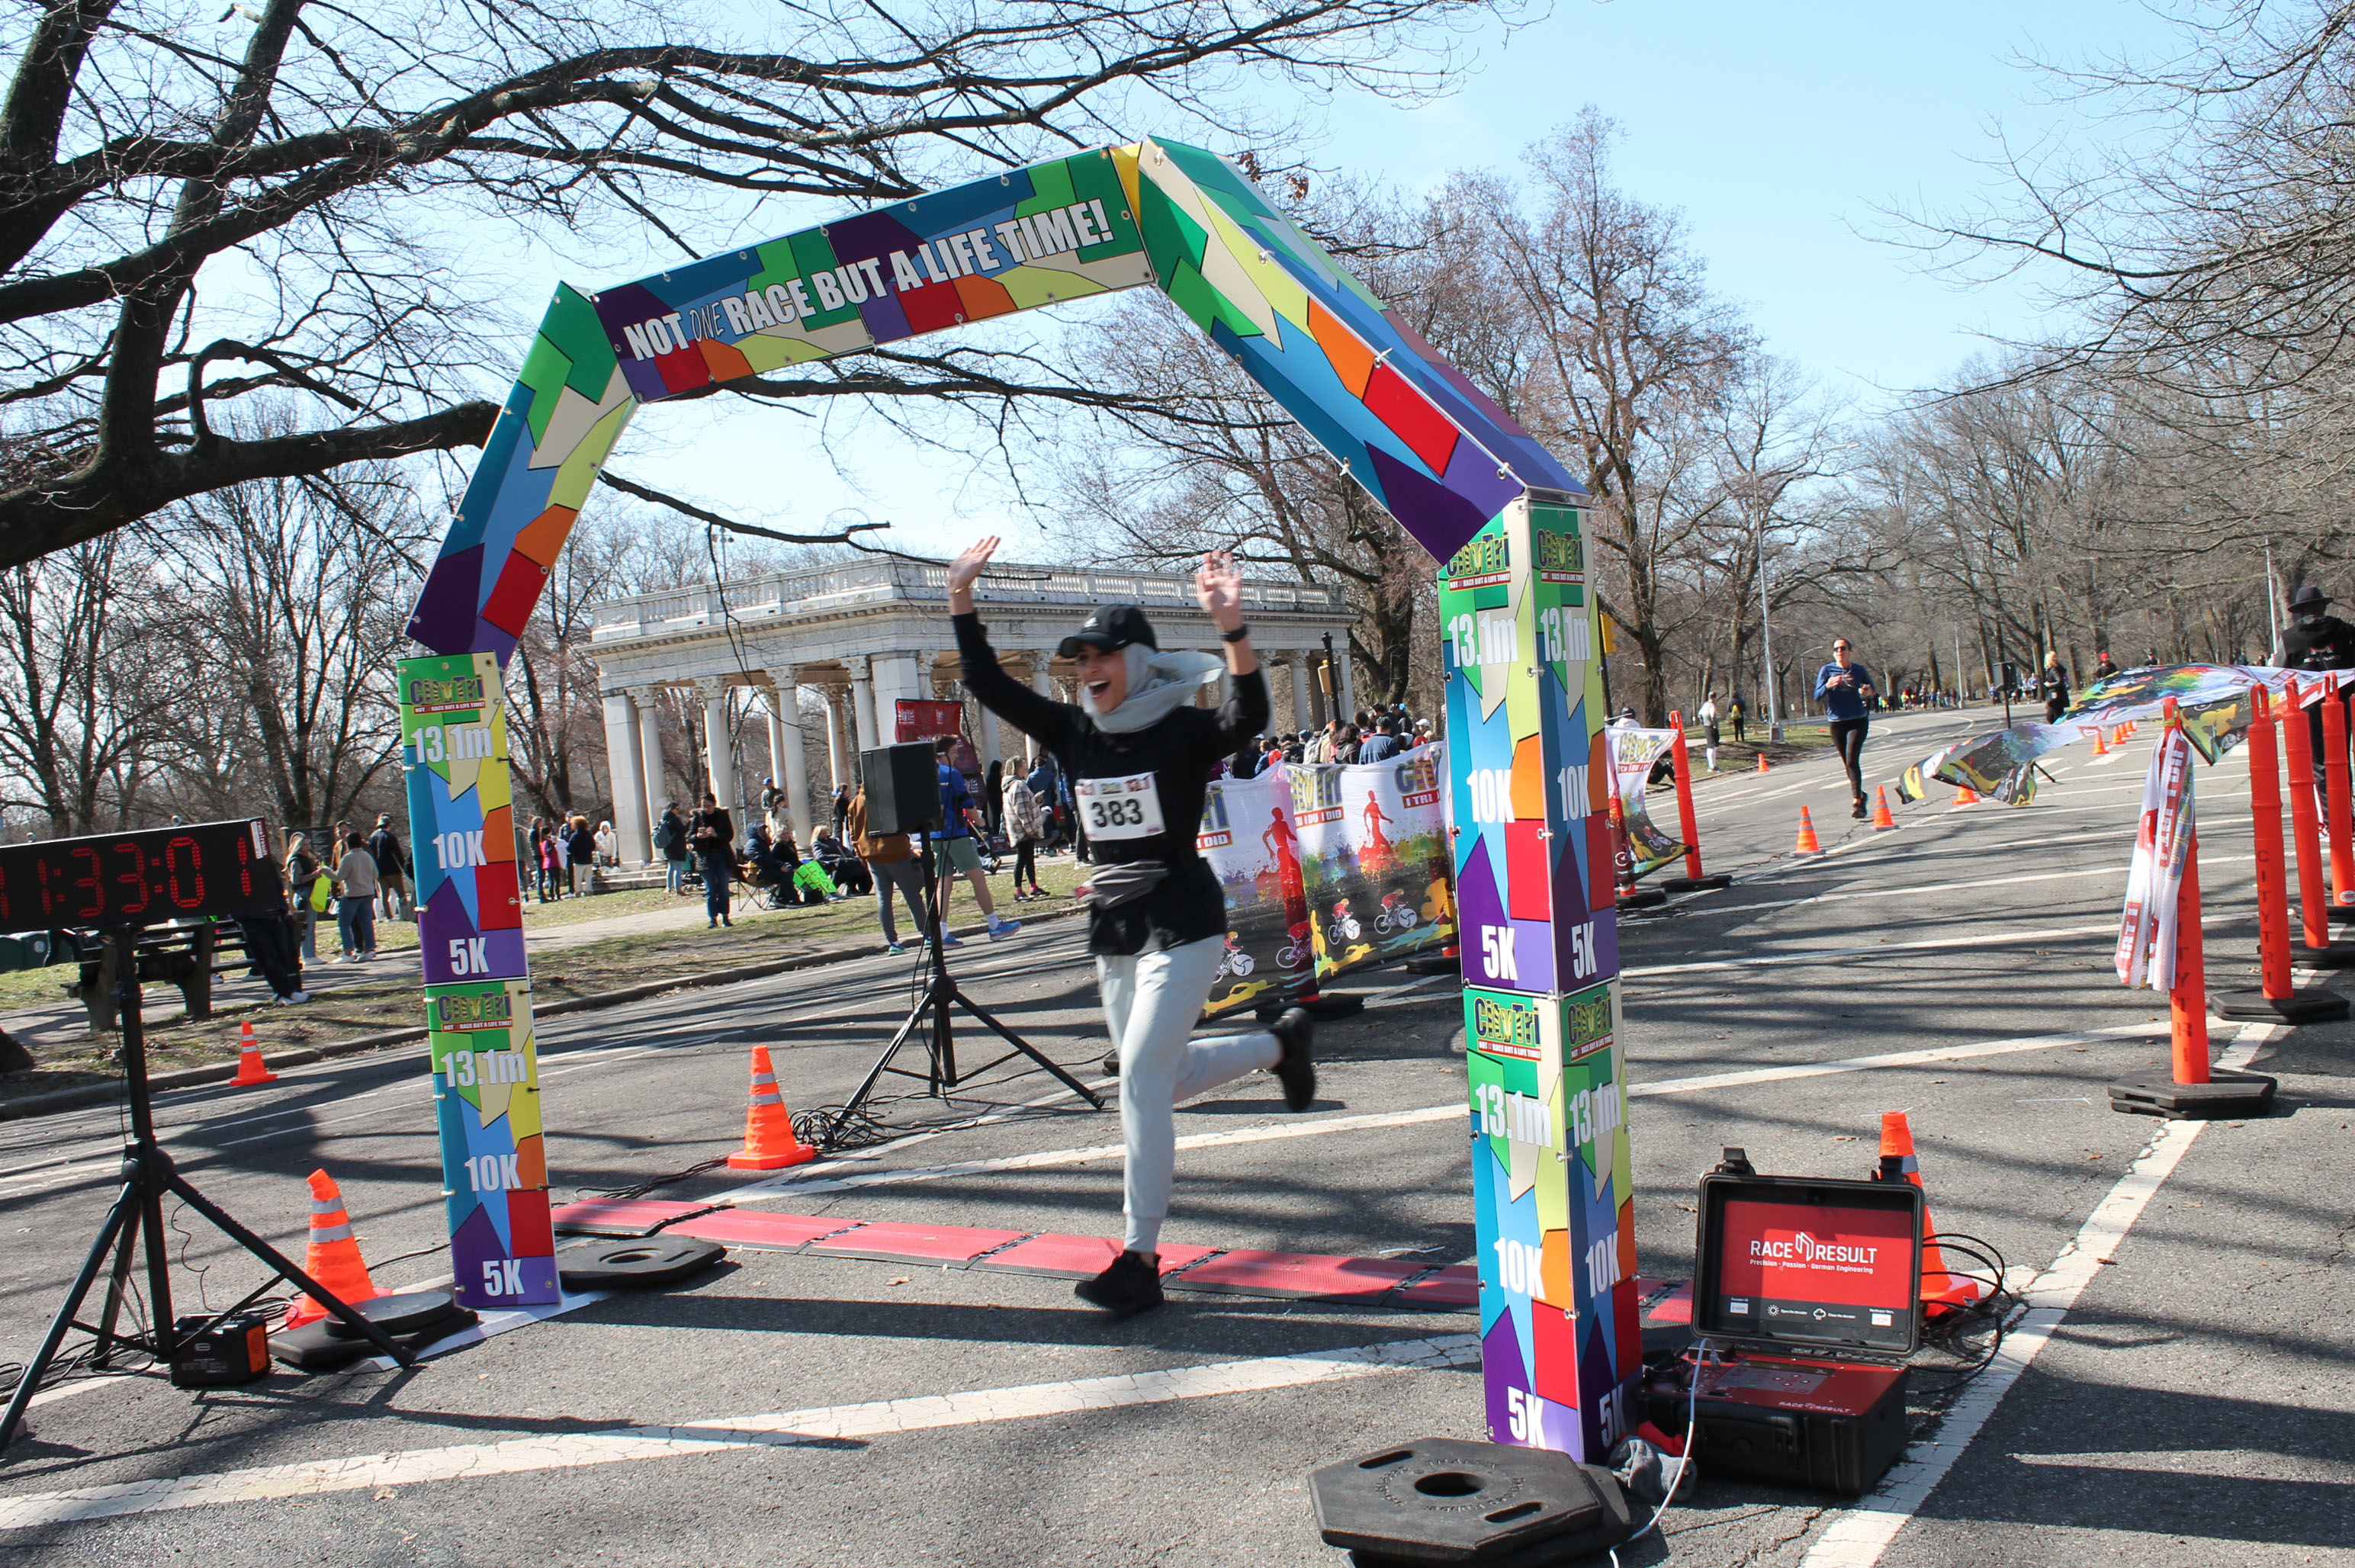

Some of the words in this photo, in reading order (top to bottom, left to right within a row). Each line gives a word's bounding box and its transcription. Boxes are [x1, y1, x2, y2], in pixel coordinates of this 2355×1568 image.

[623, 312, 689, 361] NOT
[689, 302, 724, 342] ONE
[721, 278, 817, 336] RACE
[811, 257, 888, 311] BUT
[889, 250, 924, 292] A
[917, 227, 1001, 284] LIFE
[994, 198, 1115, 264] TIME!
[1537, 529, 1584, 570] CityTri
[1447, 612, 1518, 667] 13.1m
[1540, 608, 1591, 662] 13.1m
[410, 675, 484, 704] CityTri
[411, 724, 493, 763] 13.1m
[1091, 798, 1142, 827] 383
[1325, 810, 1341, 821] DID
[1406, 797, 1412, 807] I
[1412, 793, 1433, 805] TRI
[1467, 768, 1515, 824] 10K
[1557, 765, 1592, 821] 10K
[432, 830, 487, 869] 10K
[1204, 834, 1229, 847] DID
[2257, 850, 2274, 983] CITYTRI
[449, 937, 490, 975] 5K
[1482, 925, 1518, 981] 5K
[1572, 921, 1597, 979] 5K
[439, 991, 512, 1021] CityTri
[1474, 997, 1541, 1045] CityTri
[1568, 993, 1612, 1046] CityTri
[441, 1049, 527, 1087] 13.1m
[1475, 1083, 1552, 1148] 13.1m
[1569, 1083, 1621, 1147] 13.1m
[464, 1154, 522, 1191] 10K
[1494, 1237, 1545, 1300] 10K
[1586, 1231, 1621, 1298] 10K
[1749, 1258, 1778, 1267] Precision
[1836, 1265, 1874, 1274] Engineering
[1750, 1240, 1794, 1258] RACE
[1816, 1245, 1878, 1264] RESULT
[483, 1259, 525, 1296] 5K
[1508, 1386, 1546, 1448] 5K
[1599, 1383, 1626, 1448] 5K
